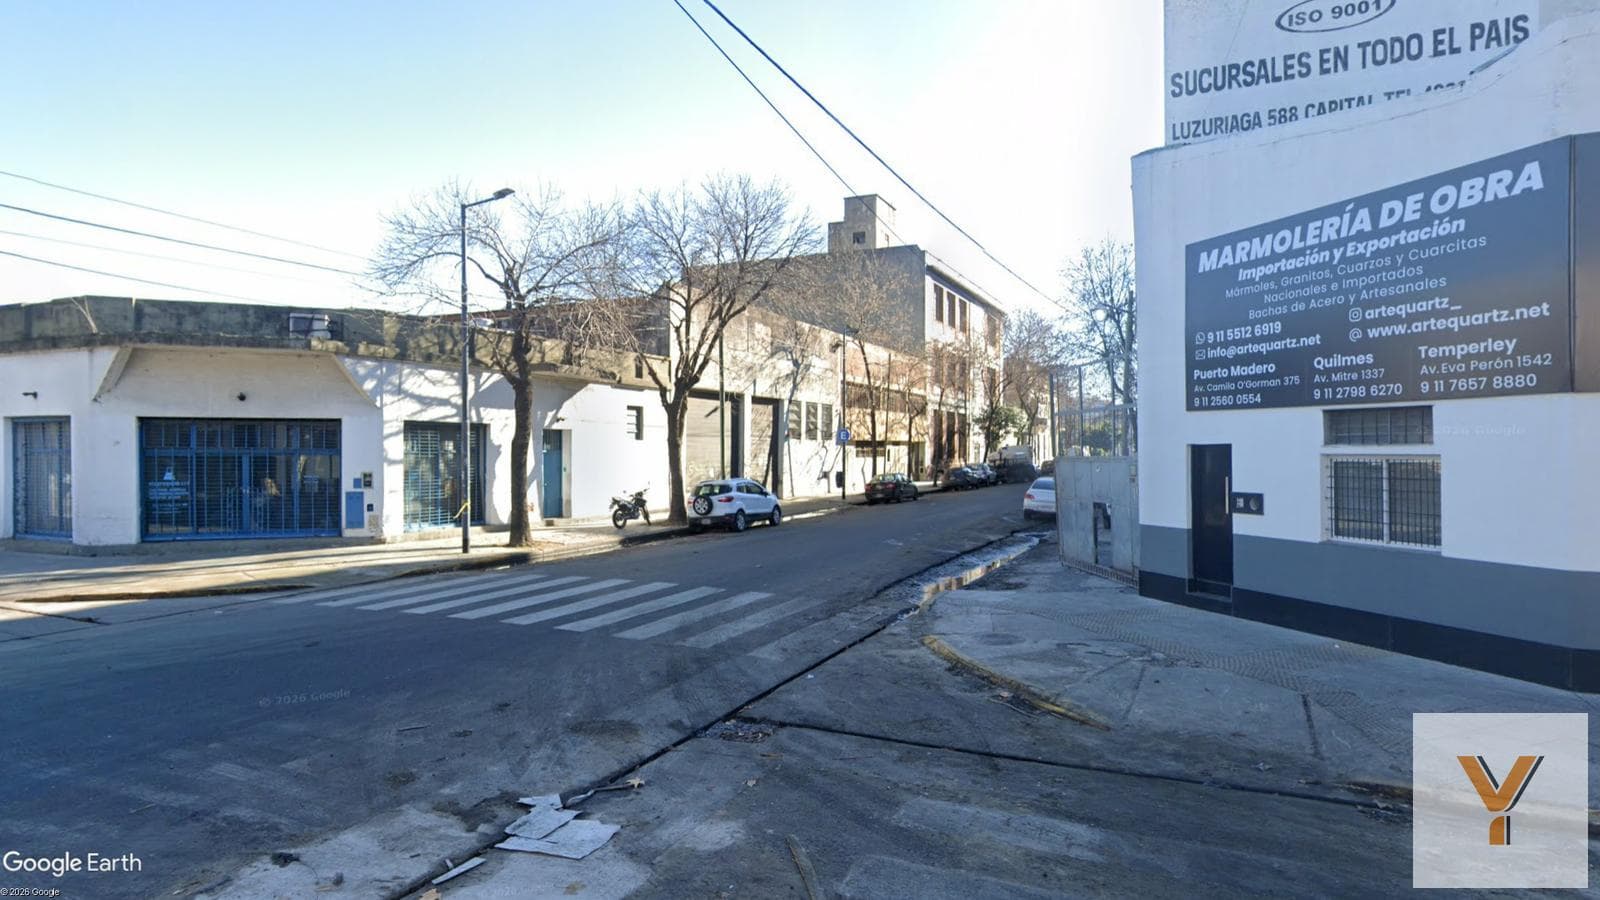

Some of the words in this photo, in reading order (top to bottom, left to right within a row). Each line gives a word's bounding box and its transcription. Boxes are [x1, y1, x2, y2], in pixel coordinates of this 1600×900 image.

[1288, 9, 1323, 27] ISO
[1331, 0, 1382, 20] 9001
[1170, 51, 1312, 98] SUCURSALES
[1319, 45, 1349, 76] EN
[1357, 32, 1423, 69] TODO
[1432, 27, 1462, 57] EL
[1470, 14, 1530, 52] PAIS
[1172, 111, 1263, 141] LUZURIAGA
[1267, 106, 1299, 127] 588
[1198, 203, 1372, 273] MARMOLERÍA
[1379, 192, 1424, 229] DE
[1430, 161, 1545, 215] OBRA
[1238, 248, 1330, 282] Importación
[1332, 247, 1345, 264] y
[1345, 217, 1466, 257] Exportación
[1225, 280, 1278, 298] Mármoles,
[1281, 269, 1333, 287] Granitos,
[1337, 256, 1391, 275] Cuarzos
[1396, 253, 1405, 265] y
[1408, 236, 1487, 261] Cuarcitas
[1264, 283, 1327, 303] Nacionales
[1331, 282, 1338, 291] e
[1342, 265, 1423, 289] Importados
[1249, 303, 1288, 320] Bachas
[1291, 299, 1306, 312] de
[1309, 295, 1345, 310] Acero
[1349, 293, 1356, 305] y
[1360, 277, 1447, 301] Artesanales
[1365, 297, 1462, 318] artequartz_
[1367, 302, 1550, 338] www.artequartz.net
[1207, 332, 1214, 343] 9
[1216, 330, 1224, 342] 11
[1227, 326, 1252, 340] 5512
[1254, 321, 1282, 336] 6919
[1207, 334, 1321, 358] info@artequartz.net
[1418, 338, 1517, 360] Temperley
[1194, 367, 1228, 380] Puerto
[1231, 363, 1276, 377] Madero
[1313, 353, 1374, 370] Quilmes
[1470, 357, 1513, 371] Perón
[1516, 353, 1552, 367] 1542
[1194, 385, 1205, 393] Av.
[1207, 381, 1235, 392] Camila
[1236, 378, 1281, 389] O'Gorman
[1313, 374, 1329, 383] Av.
[1331, 371, 1358, 382] Mitre
[1361, 368, 1385, 380] 1337
[1420, 381, 1429, 393] 9
[1433, 380, 1444, 392] 11
[1449, 377, 1488, 391] 7657
[1493, 373, 1537, 389] 8880
[1194, 397, 1200, 407] 9
[1202, 396, 1209, 406] 11
[1236, 393, 1261, 405] 0554
[1313, 389, 1320, 400] 9
[1324, 388, 1332, 399] 11
[1336, 385, 1366, 398] 2798
[1370, 383, 1403, 397] 6270
